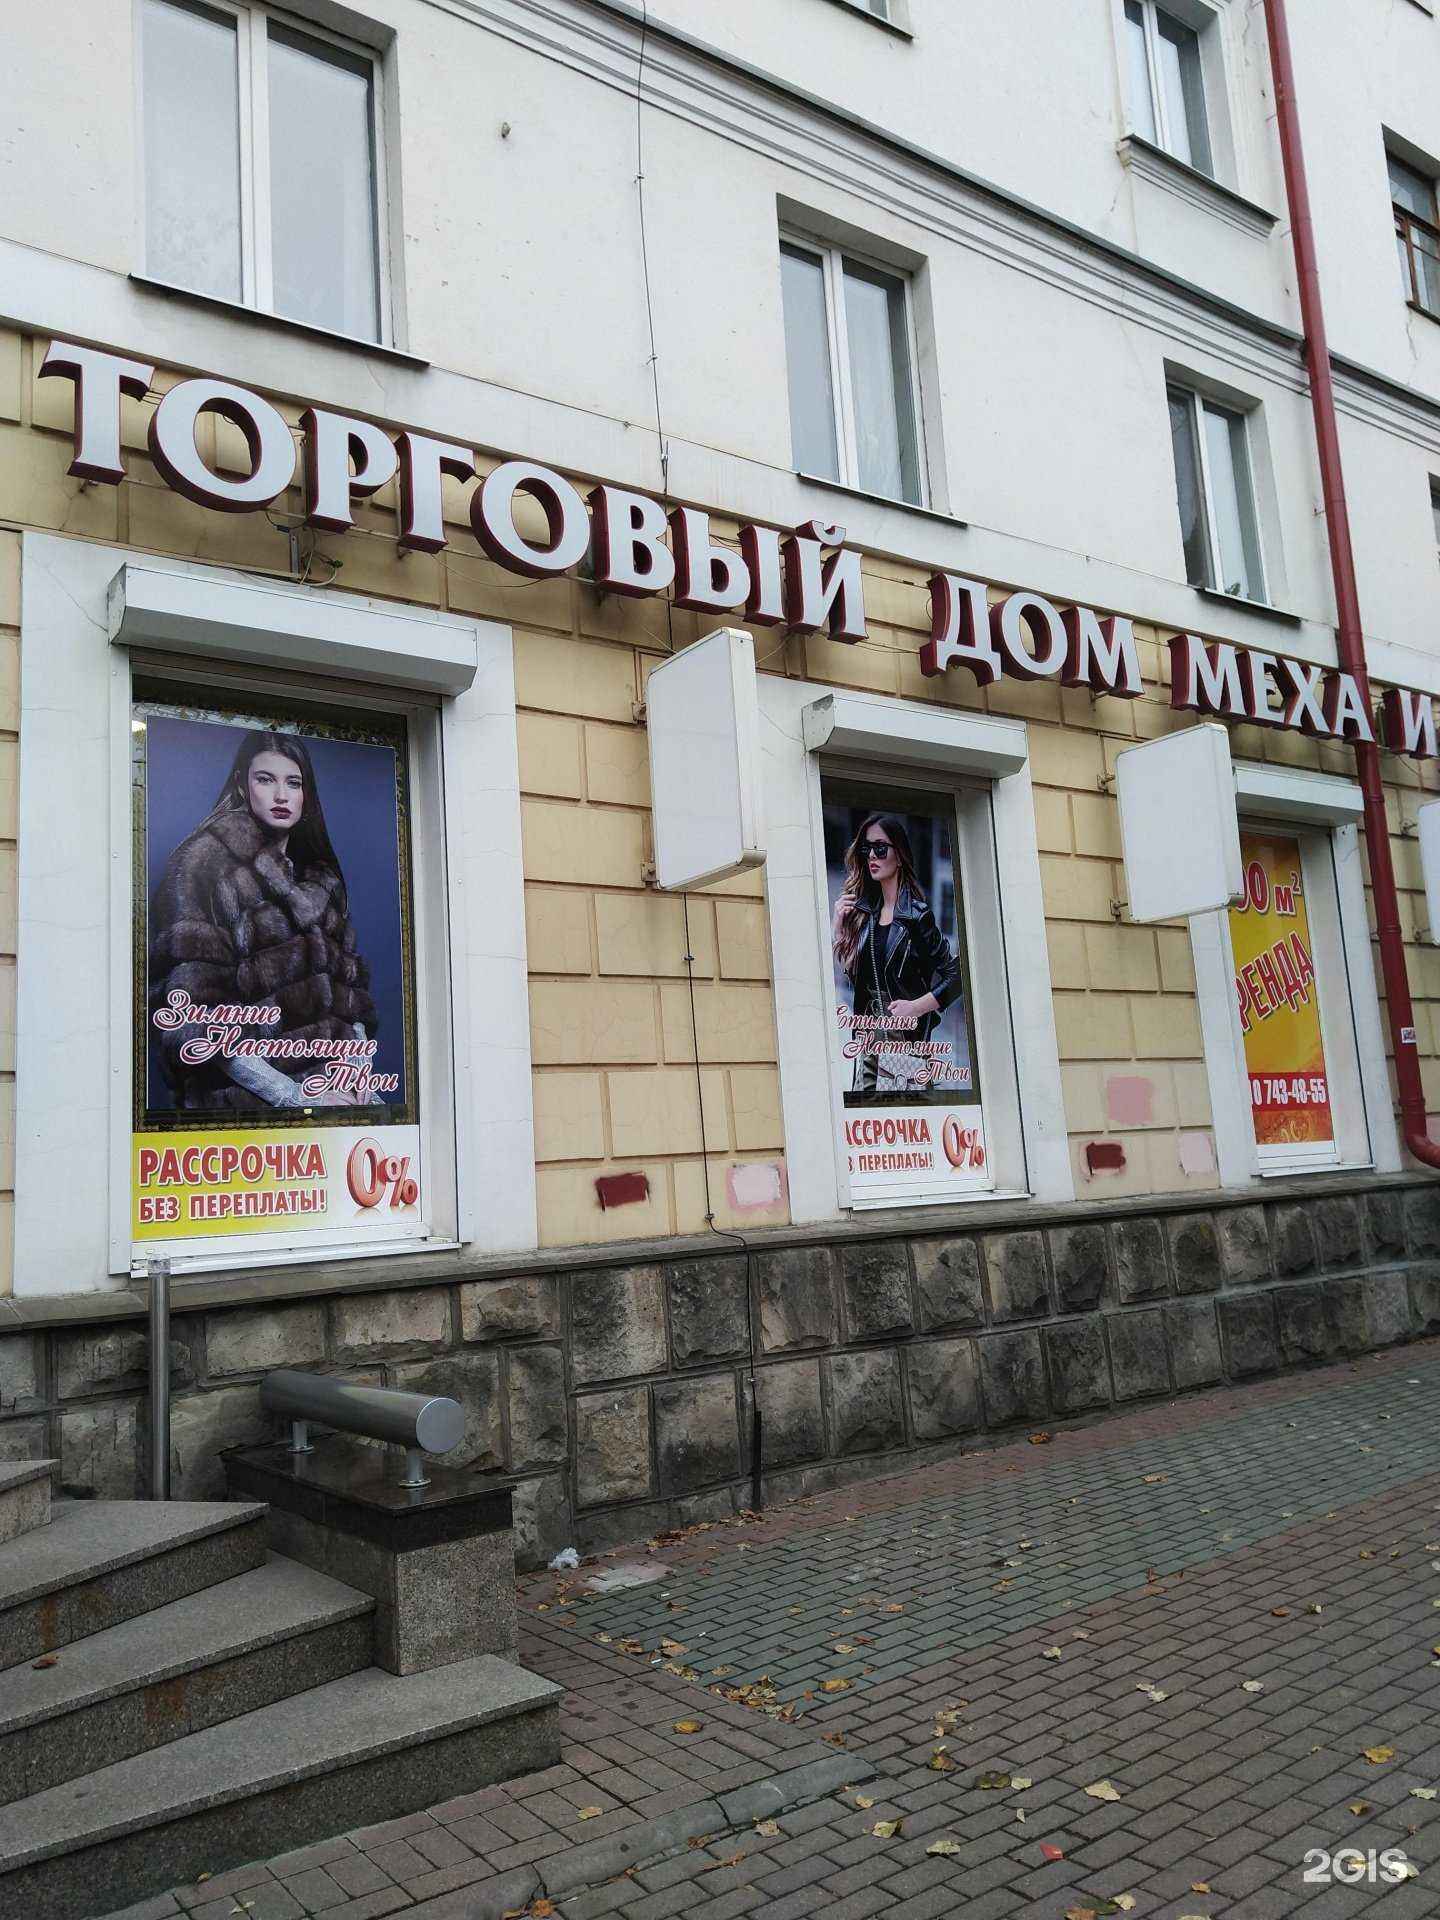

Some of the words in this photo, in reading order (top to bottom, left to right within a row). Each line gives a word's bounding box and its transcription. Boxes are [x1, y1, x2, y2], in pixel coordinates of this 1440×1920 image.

[38, 339, 869, 644] ТОРГОВЫЙ
[920, 571, 1144, 699] ДОМ
[1167, 633, 1376, 743] МЕХА
[1382, 687, 1440, 760] И
[153, 989, 281, 1030] Зимние
[180, 1026, 378, 1065] Настоящие
[842, 1031, 952, 1059] Настоящие
[302, 1061, 399, 1098] Твои
[914, 1058, 970, 1086] Твои
[942, 1113, 985, 1168] 0%
[139, 1144, 328, 1187] РАССРОЧКА
[346, 1136, 419, 1208] 0%
[858, 1151, 934, 1173] ПЕРЕПЛАТЫ!
[139, 1196, 180, 1222] БЕЗ
[190, 1189, 328, 1219] ПЕРЕПЛАТЫ!
